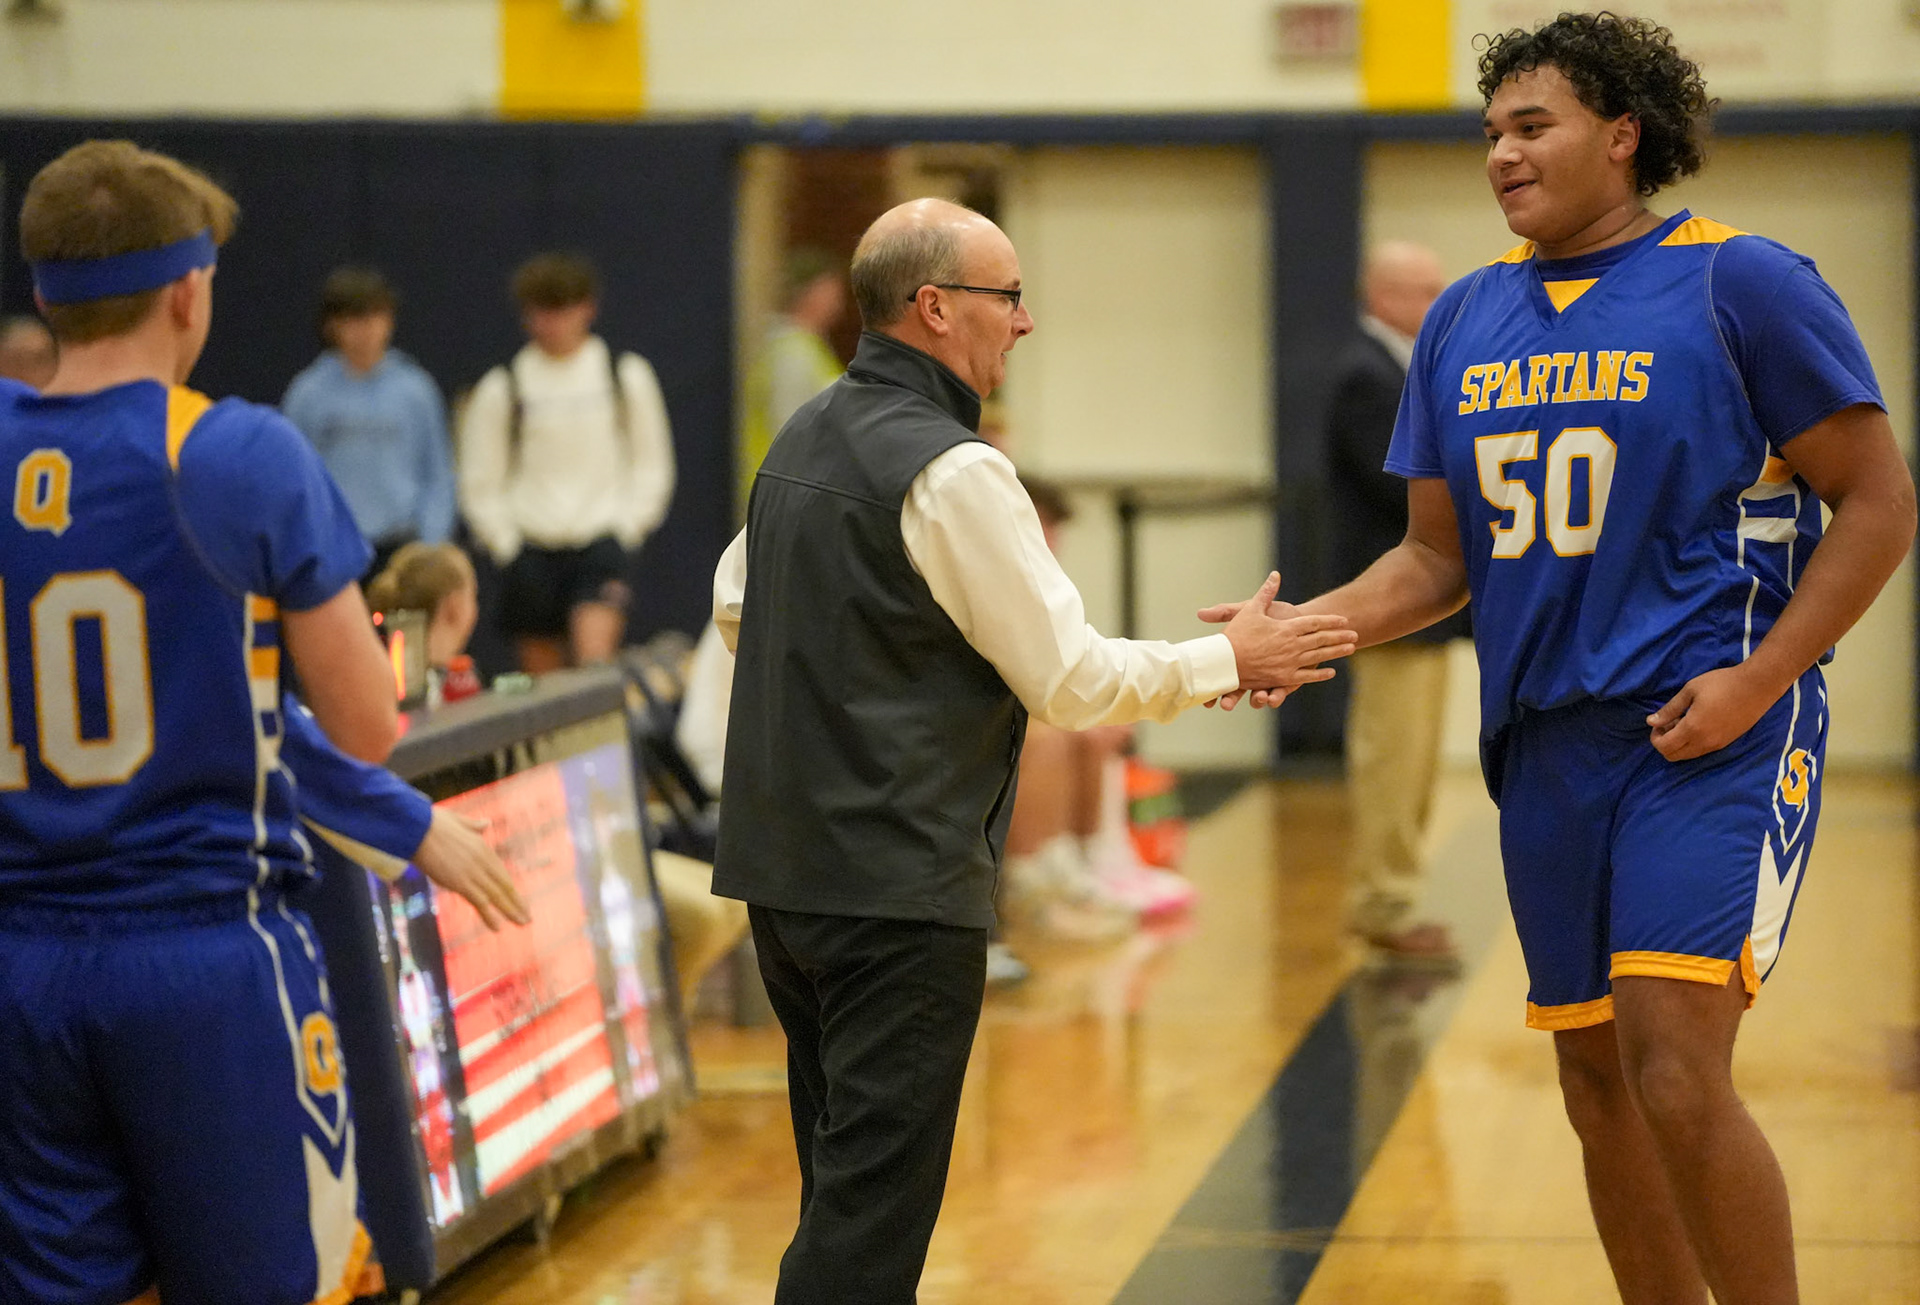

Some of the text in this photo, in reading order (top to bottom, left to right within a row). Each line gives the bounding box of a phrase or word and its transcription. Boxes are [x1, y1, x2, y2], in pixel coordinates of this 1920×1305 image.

[1458, 350, 1654, 416] SPARTANS
[13, 447, 72, 537] Q
[1474, 426, 1618, 560] 50
